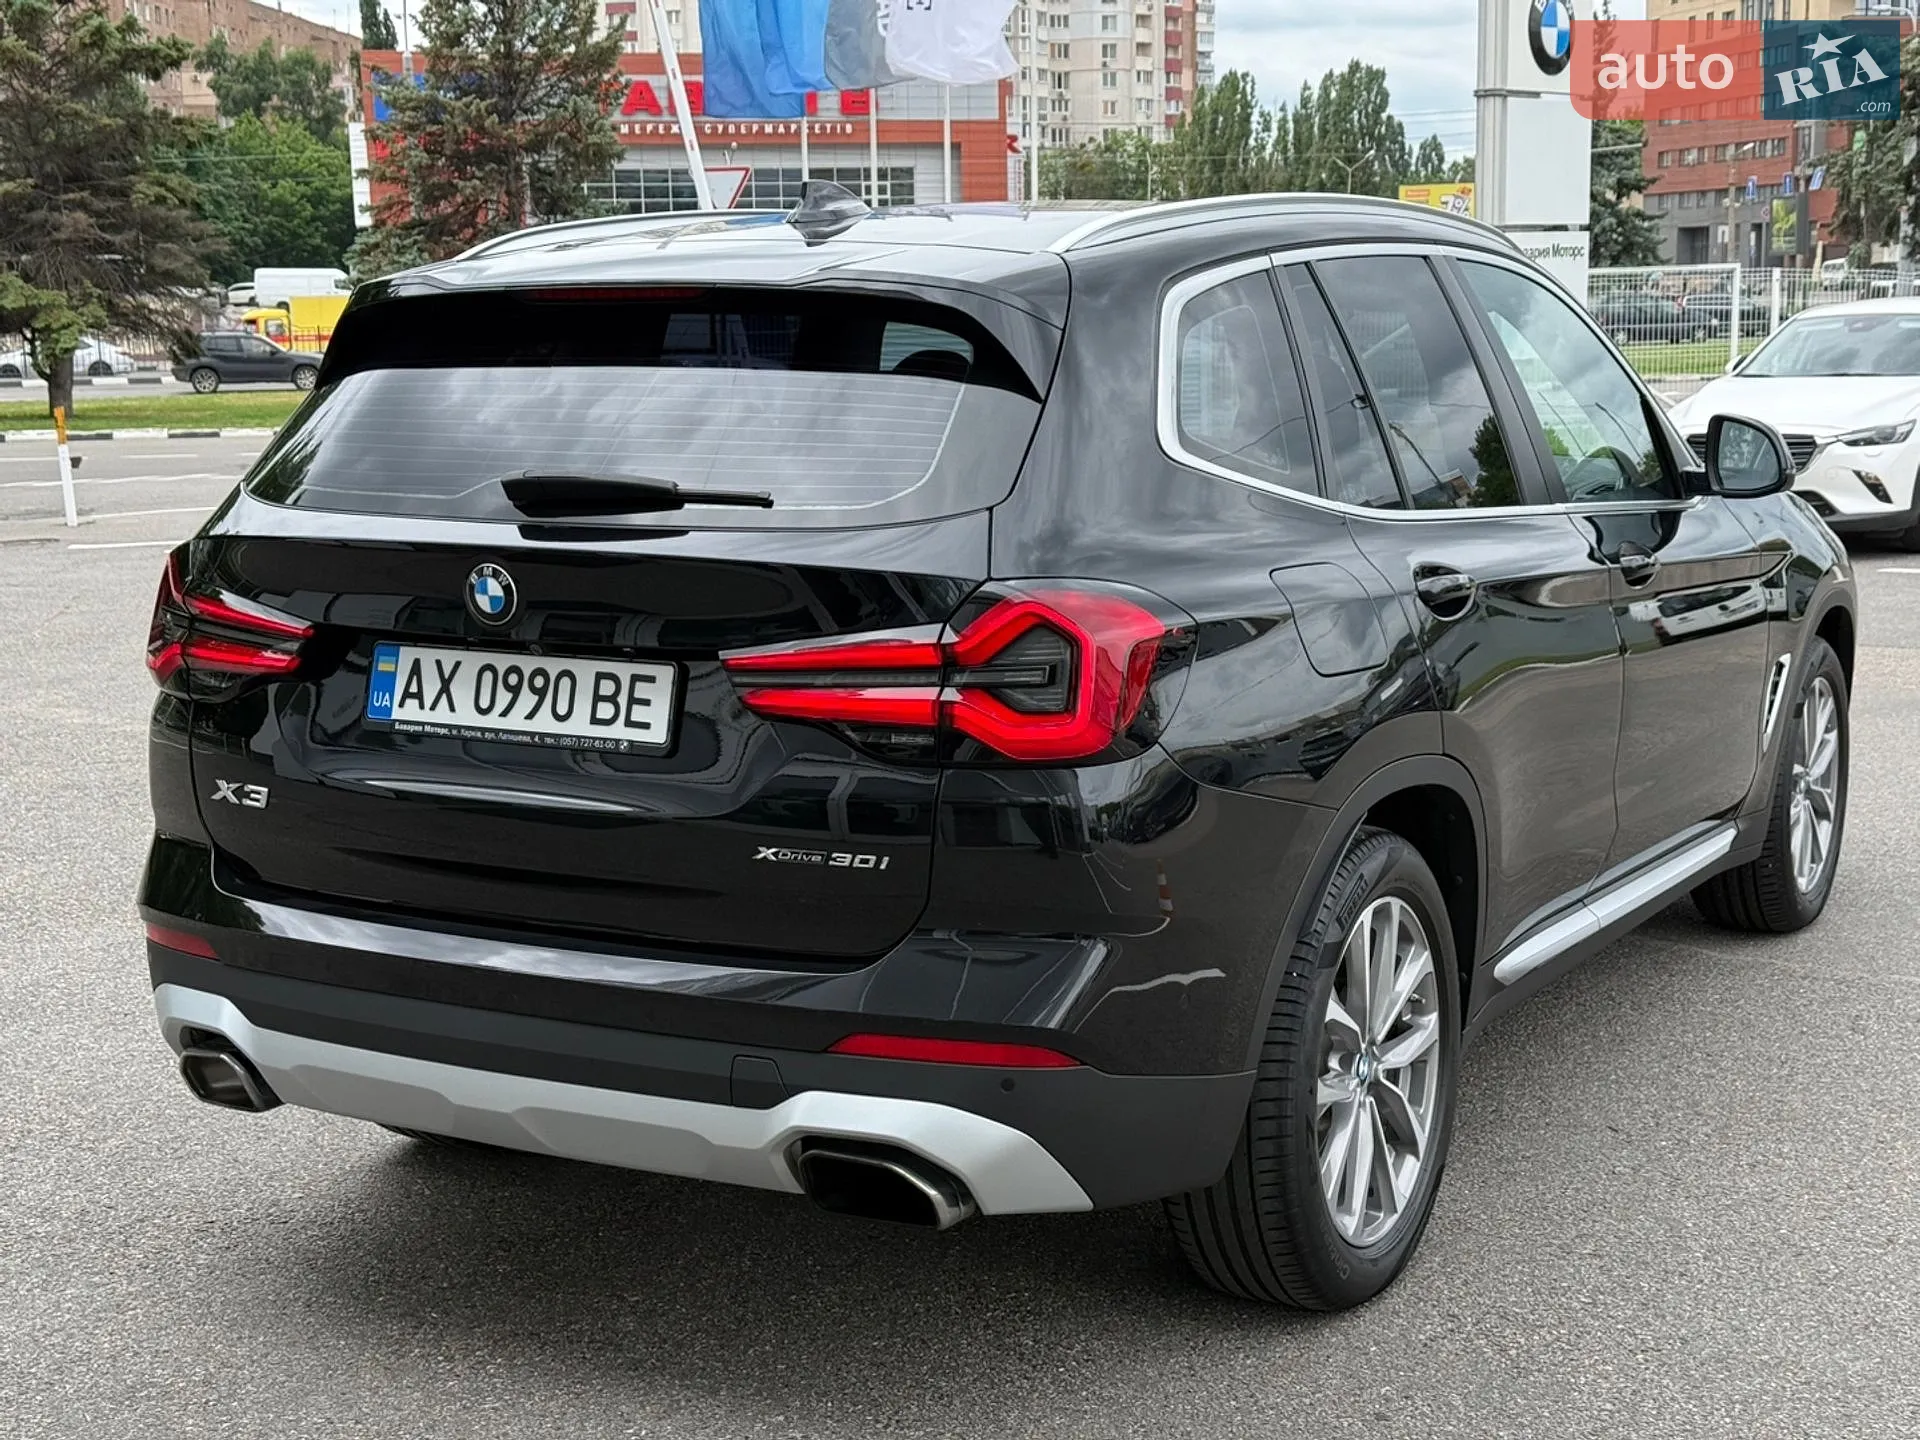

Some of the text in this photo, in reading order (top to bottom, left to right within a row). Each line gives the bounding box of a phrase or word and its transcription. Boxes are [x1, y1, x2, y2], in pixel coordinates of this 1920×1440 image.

[620, 123, 682, 135] МЕРЕЖ
[1552, 243, 1585, 261] Моторс
[470, 565, 510, 587] BMW
[373, 690, 392, 708] UA
[398, 656, 657, 730] AX 0990 BE
[210, 779, 269, 809] X3
